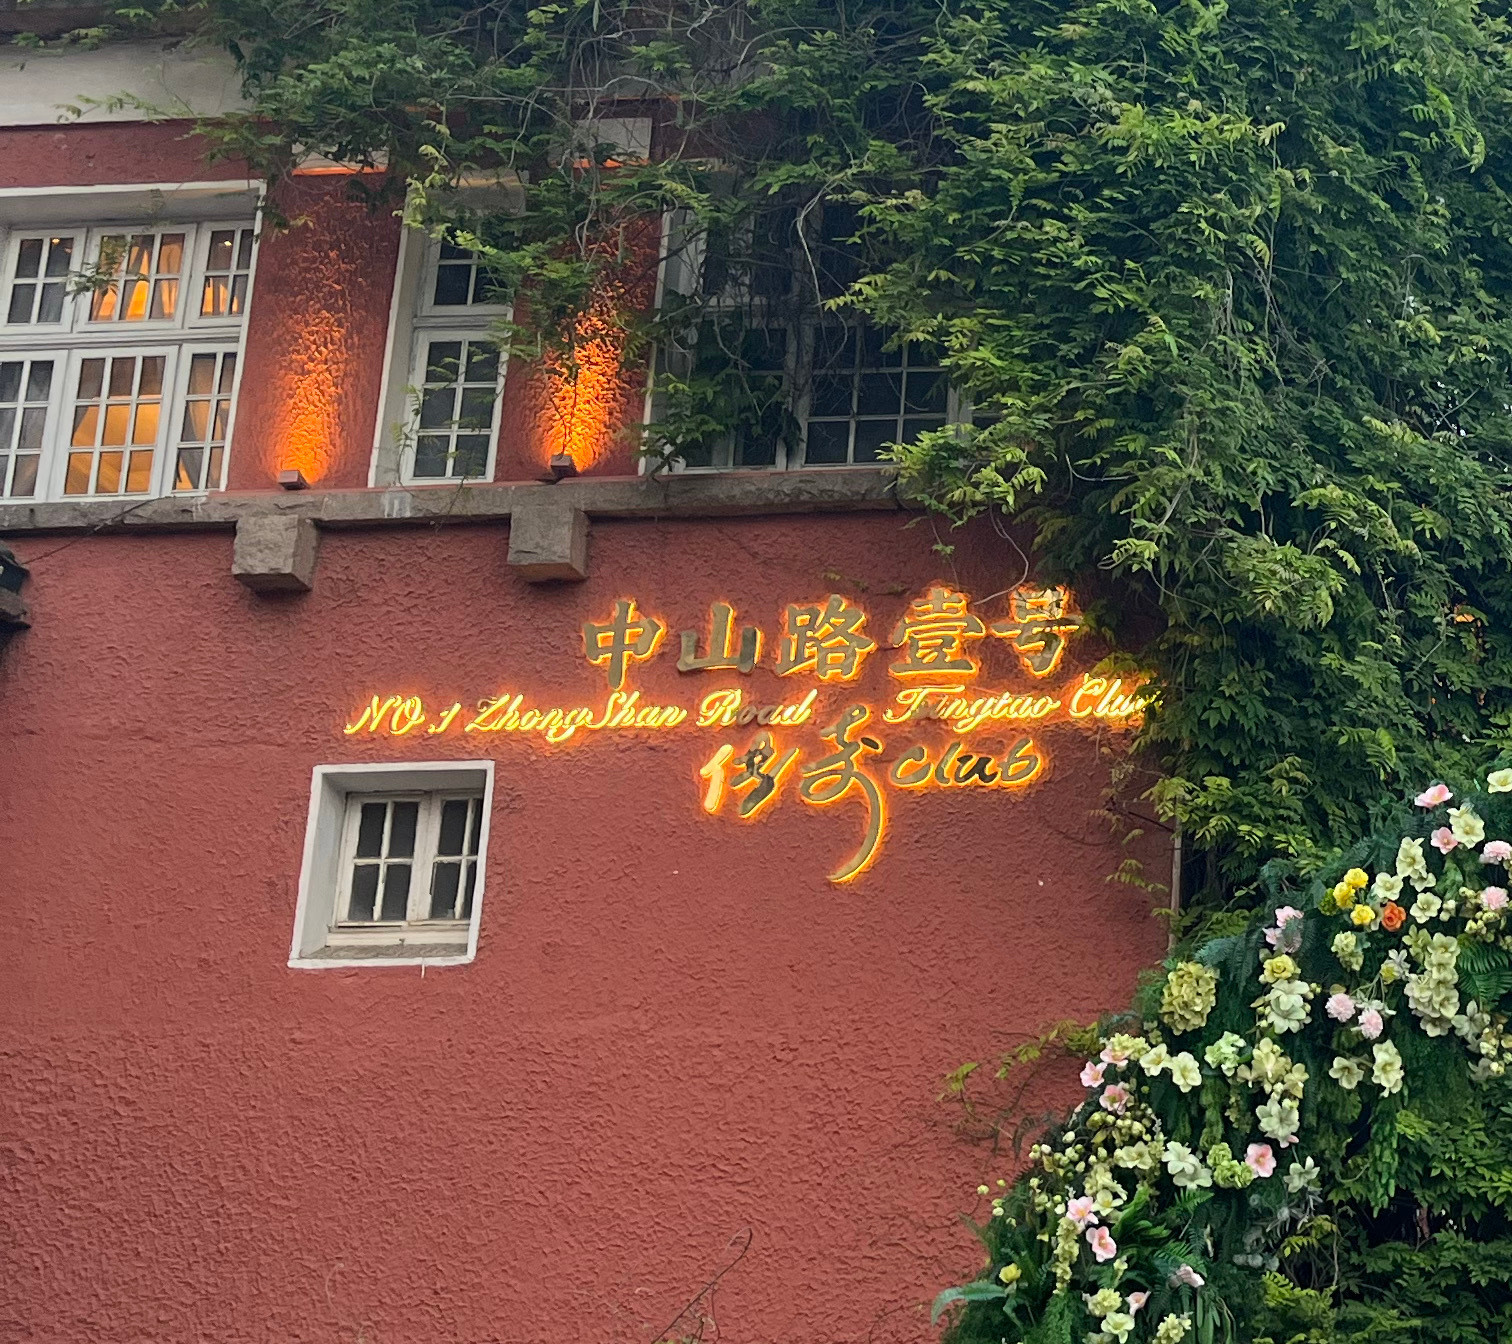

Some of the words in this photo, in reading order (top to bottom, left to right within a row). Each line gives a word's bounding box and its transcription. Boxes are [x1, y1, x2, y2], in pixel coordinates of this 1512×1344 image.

[582, 584, 1082, 690] 中山路壹号
[696, 687, 818, 728] Road
